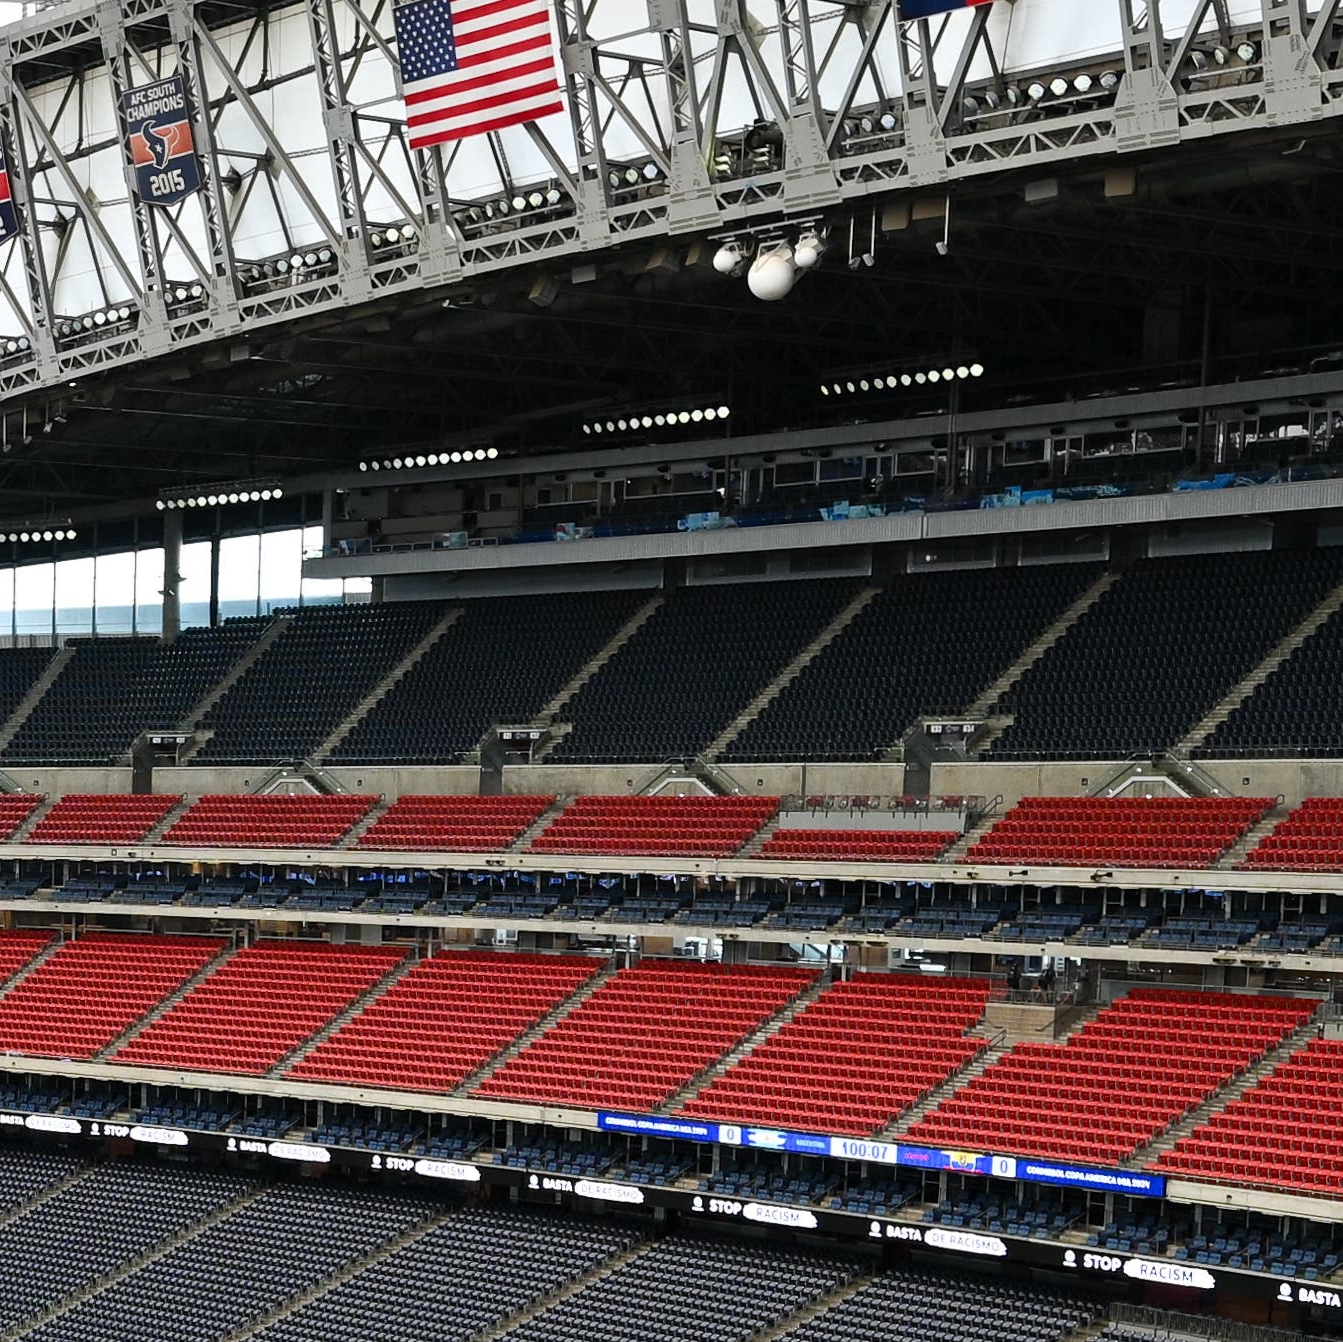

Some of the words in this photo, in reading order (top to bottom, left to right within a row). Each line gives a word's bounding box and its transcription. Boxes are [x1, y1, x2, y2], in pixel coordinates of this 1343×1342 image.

[130, 91, 147, 107] AFC
[147, 82, 176, 101] SOUTH
[126, 93, 185, 122] CHAMPIONS
[149, 169, 186, 197] 2015
[726, 1128, 735, 1142] 0
[842, 1140, 889, 1161] 100:07
[999, 1159, 1010, 1174] 0
[708, 1199, 743, 1216] STOP
[755, 1206, 800, 1223] RACISM
[885, 1223, 923, 1242] BASTA
[932, 1231, 947, 1245] DE
[950, 1234, 1002, 1253] RACISMO
[1082, 1253, 1122, 1273] STOP
[1139, 1262, 1194, 1284] RACISM
[1297, 1287, 1342, 1308] BASTA
